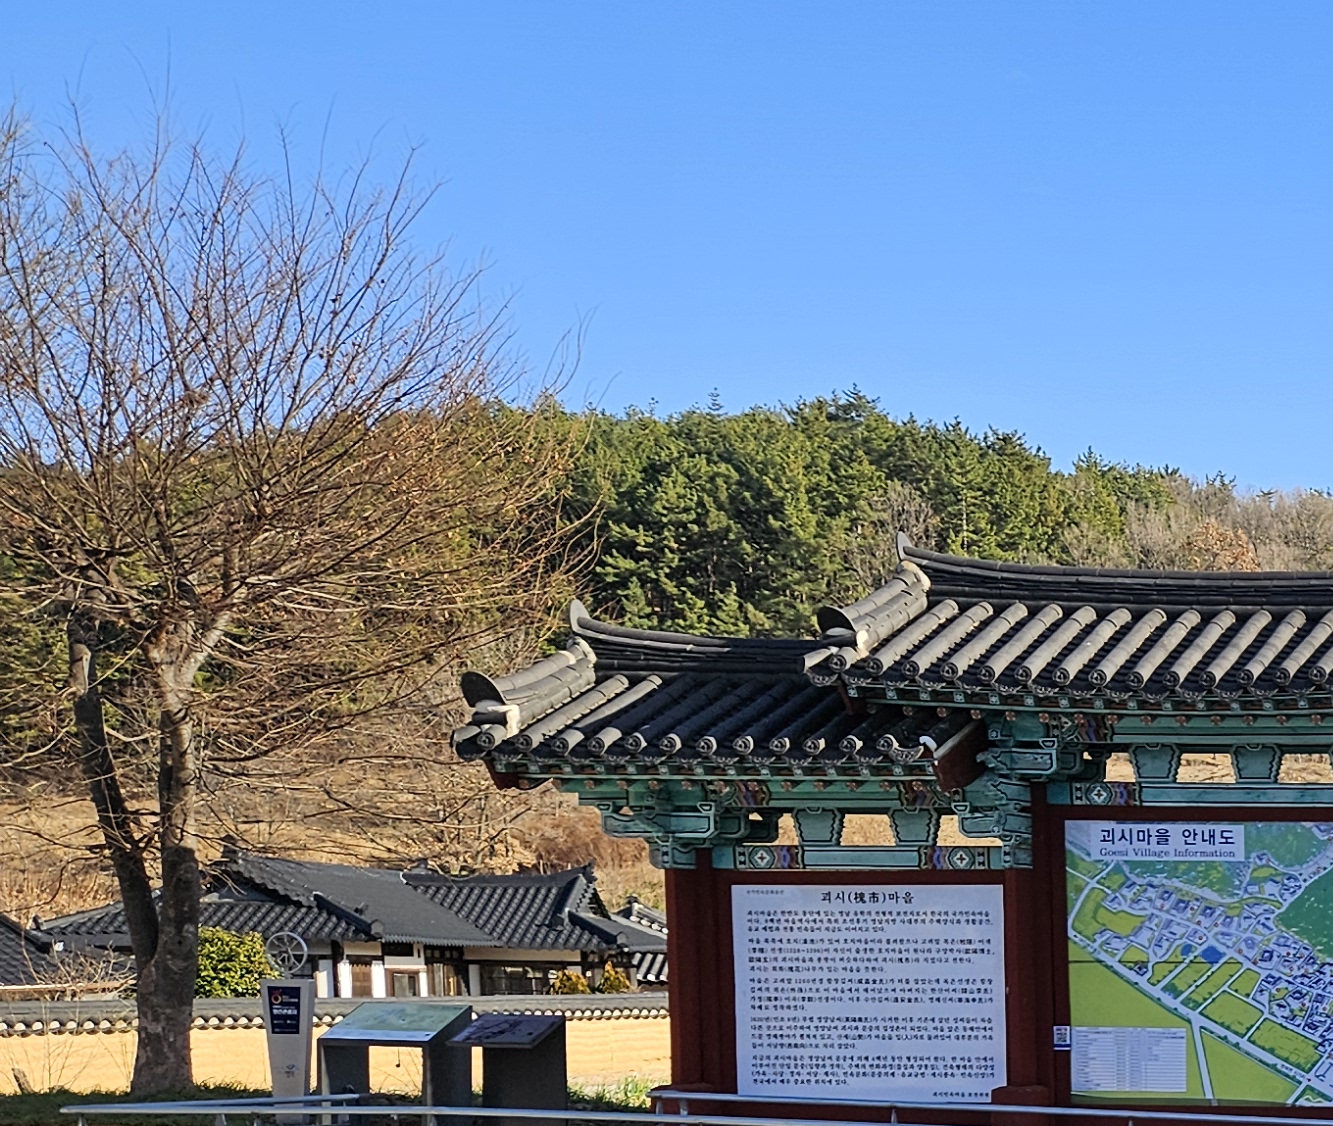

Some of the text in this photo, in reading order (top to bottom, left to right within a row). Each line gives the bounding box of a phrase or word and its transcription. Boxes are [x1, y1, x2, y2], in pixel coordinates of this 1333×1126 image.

[1099, 828, 1236, 846] 괴시마을 안내도
[1100, 848, 1236, 860] Goesi Village Information
